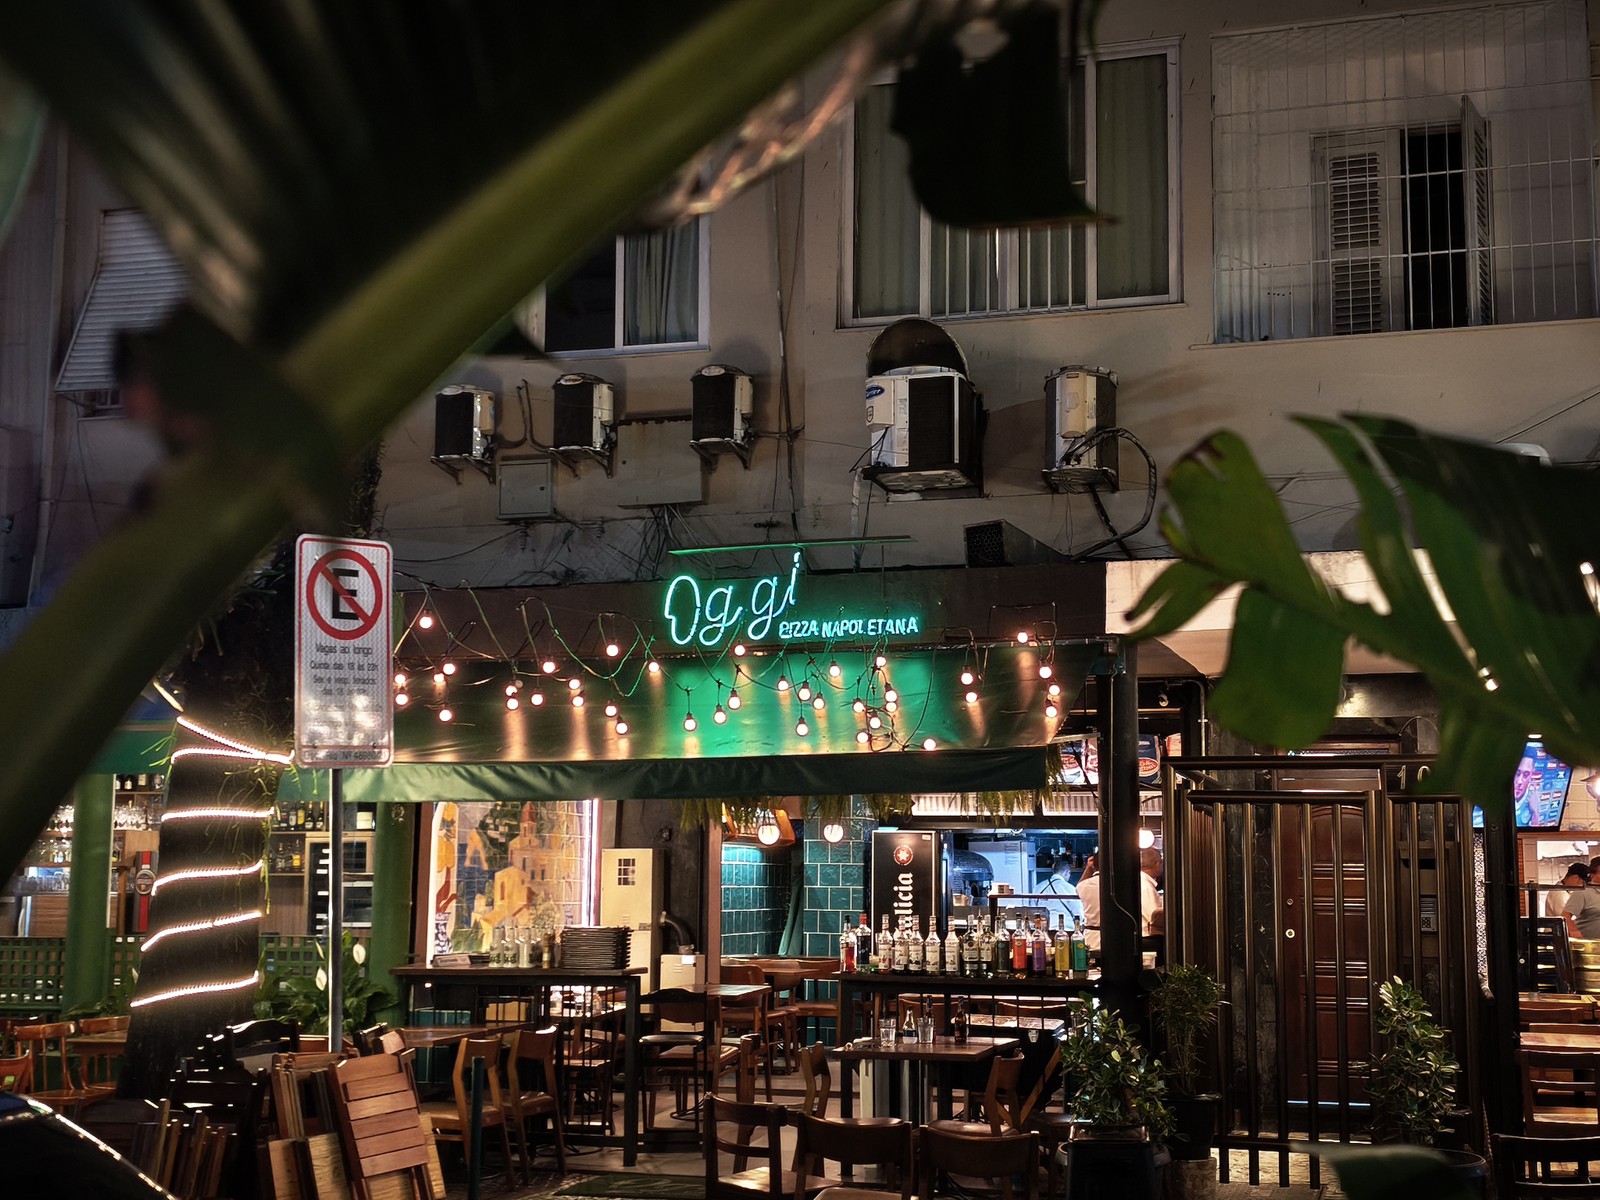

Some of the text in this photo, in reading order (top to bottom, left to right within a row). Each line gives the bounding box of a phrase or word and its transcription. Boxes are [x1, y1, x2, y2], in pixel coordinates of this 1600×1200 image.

[332, 568, 359, 620] E
[664, 551, 801, 646] Oggi
[821, 616, 919, 638] NAPOLETANA
[315, 642, 338, 656] Vagas
[353, 644, 373, 658] longo
